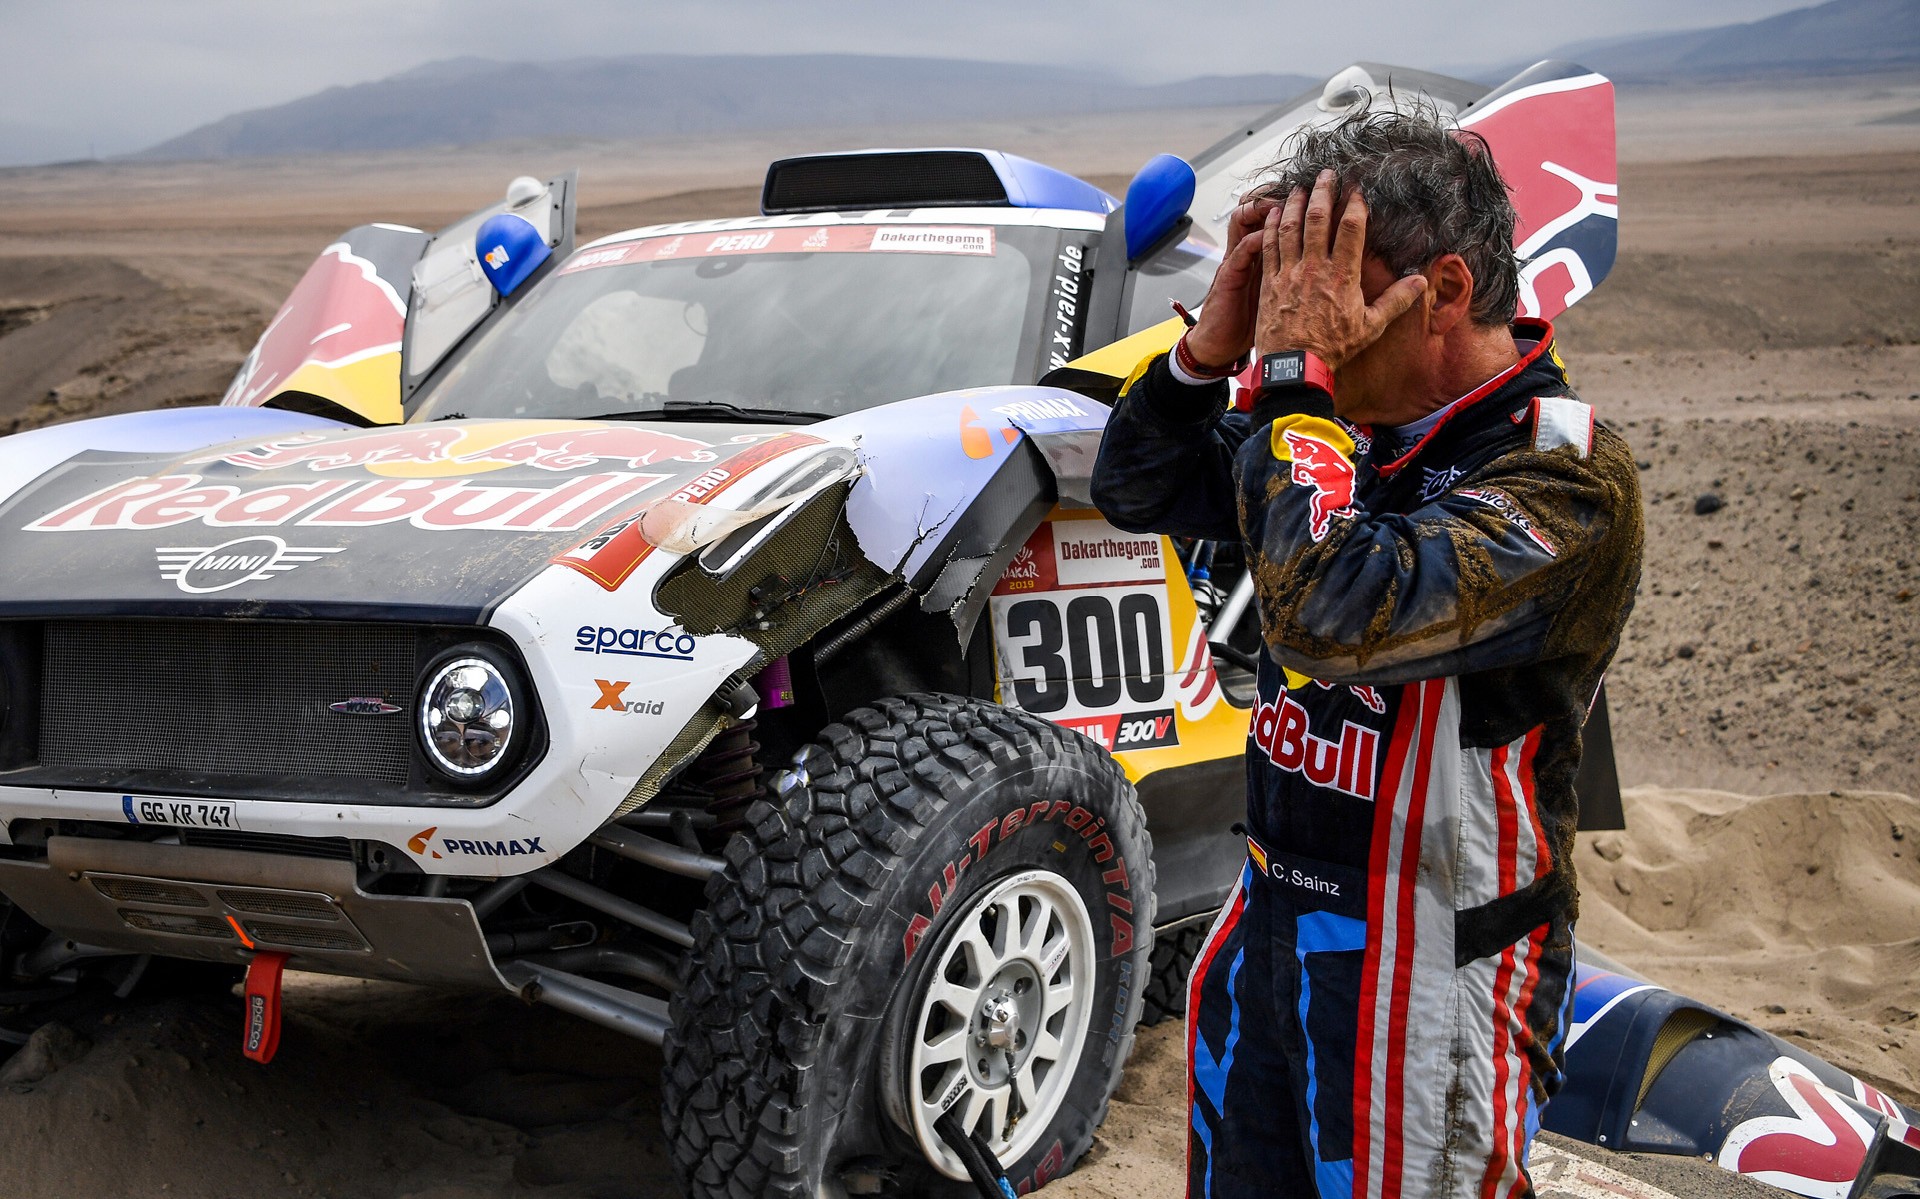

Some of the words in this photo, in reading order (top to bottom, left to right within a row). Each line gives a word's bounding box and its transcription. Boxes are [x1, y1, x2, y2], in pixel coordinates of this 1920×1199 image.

[881, 233, 985, 245] Dakarthegame
[1049, 245, 1083, 372] w.x-raid.de
[991, 398, 1089, 420] PRIMAX
[1061, 539, 1158, 560] Dakarthegame
[195, 555, 267, 570] MINI
[1140, 557, 1160, 568] .com
[1009, 580, 1034, 590] 2019
[576, 626, 695, 655] sparco
[1007, 593, 1165, 713] 300
[346, 702, 381, 713] WORKS
[1118, 716, 1172, 744] 300V
[141, 802, 168, 823] GG
[169, 803, 197, 825] XR
[198, 805, 230, 827] 747
[443, 837, 546, 856] PRIMAX
